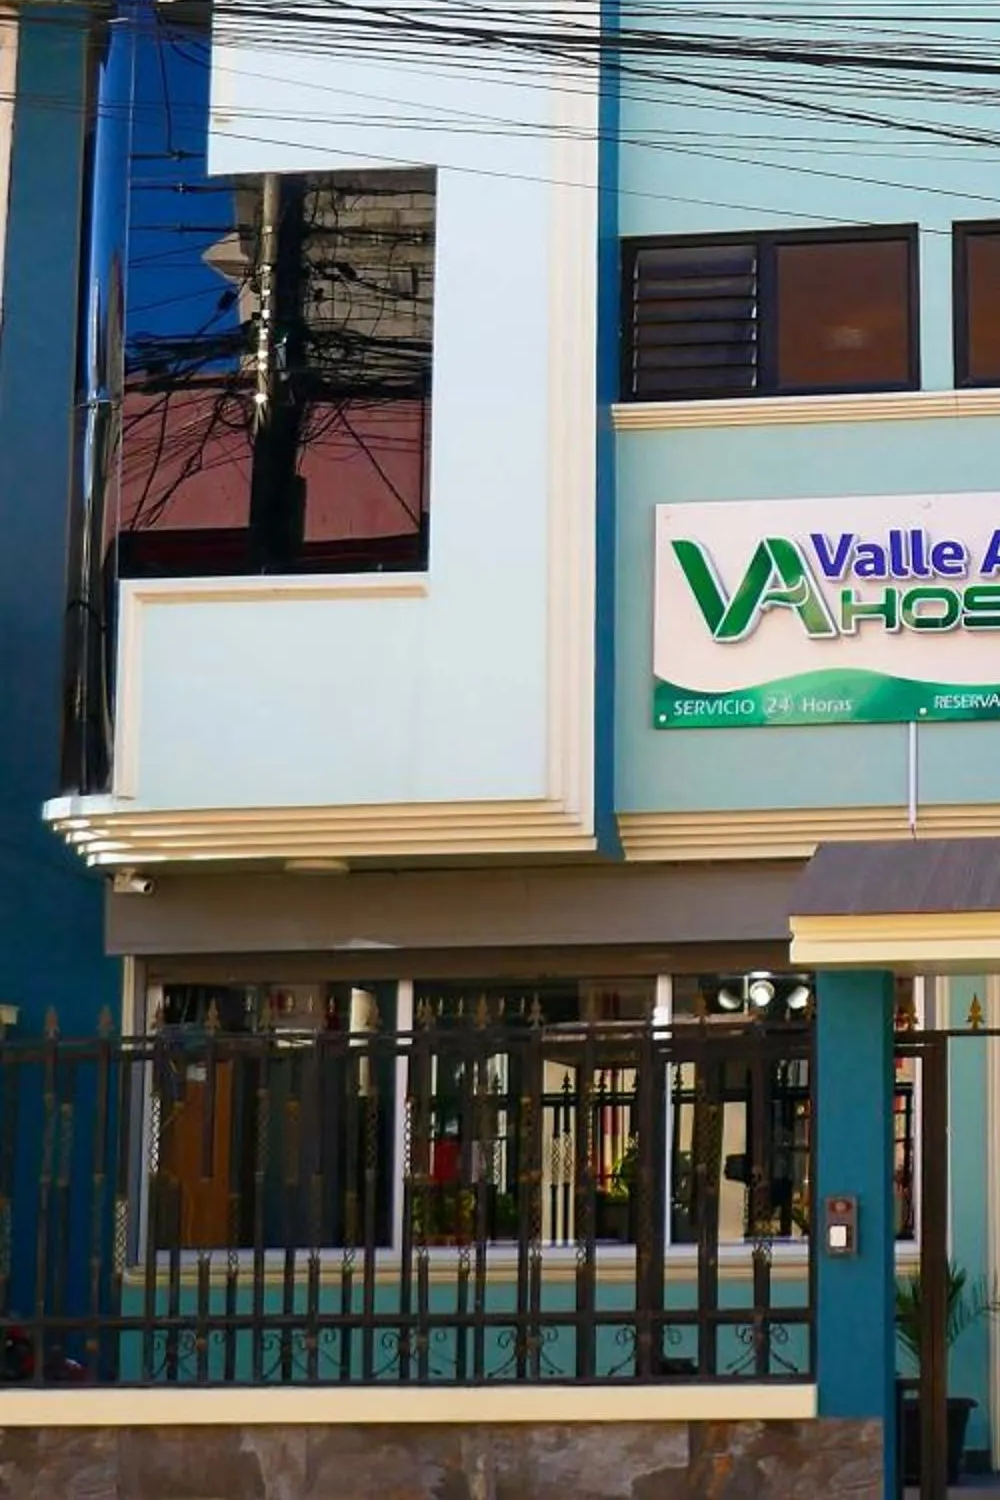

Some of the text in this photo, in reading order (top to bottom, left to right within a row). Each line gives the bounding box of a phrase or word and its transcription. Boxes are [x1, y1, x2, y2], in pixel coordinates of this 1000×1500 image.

[809, 528, 966, 580] Valle
[670, 537, 837, 642] VA
[673, 698, 852, 716] SERVICIO 24 Horas
